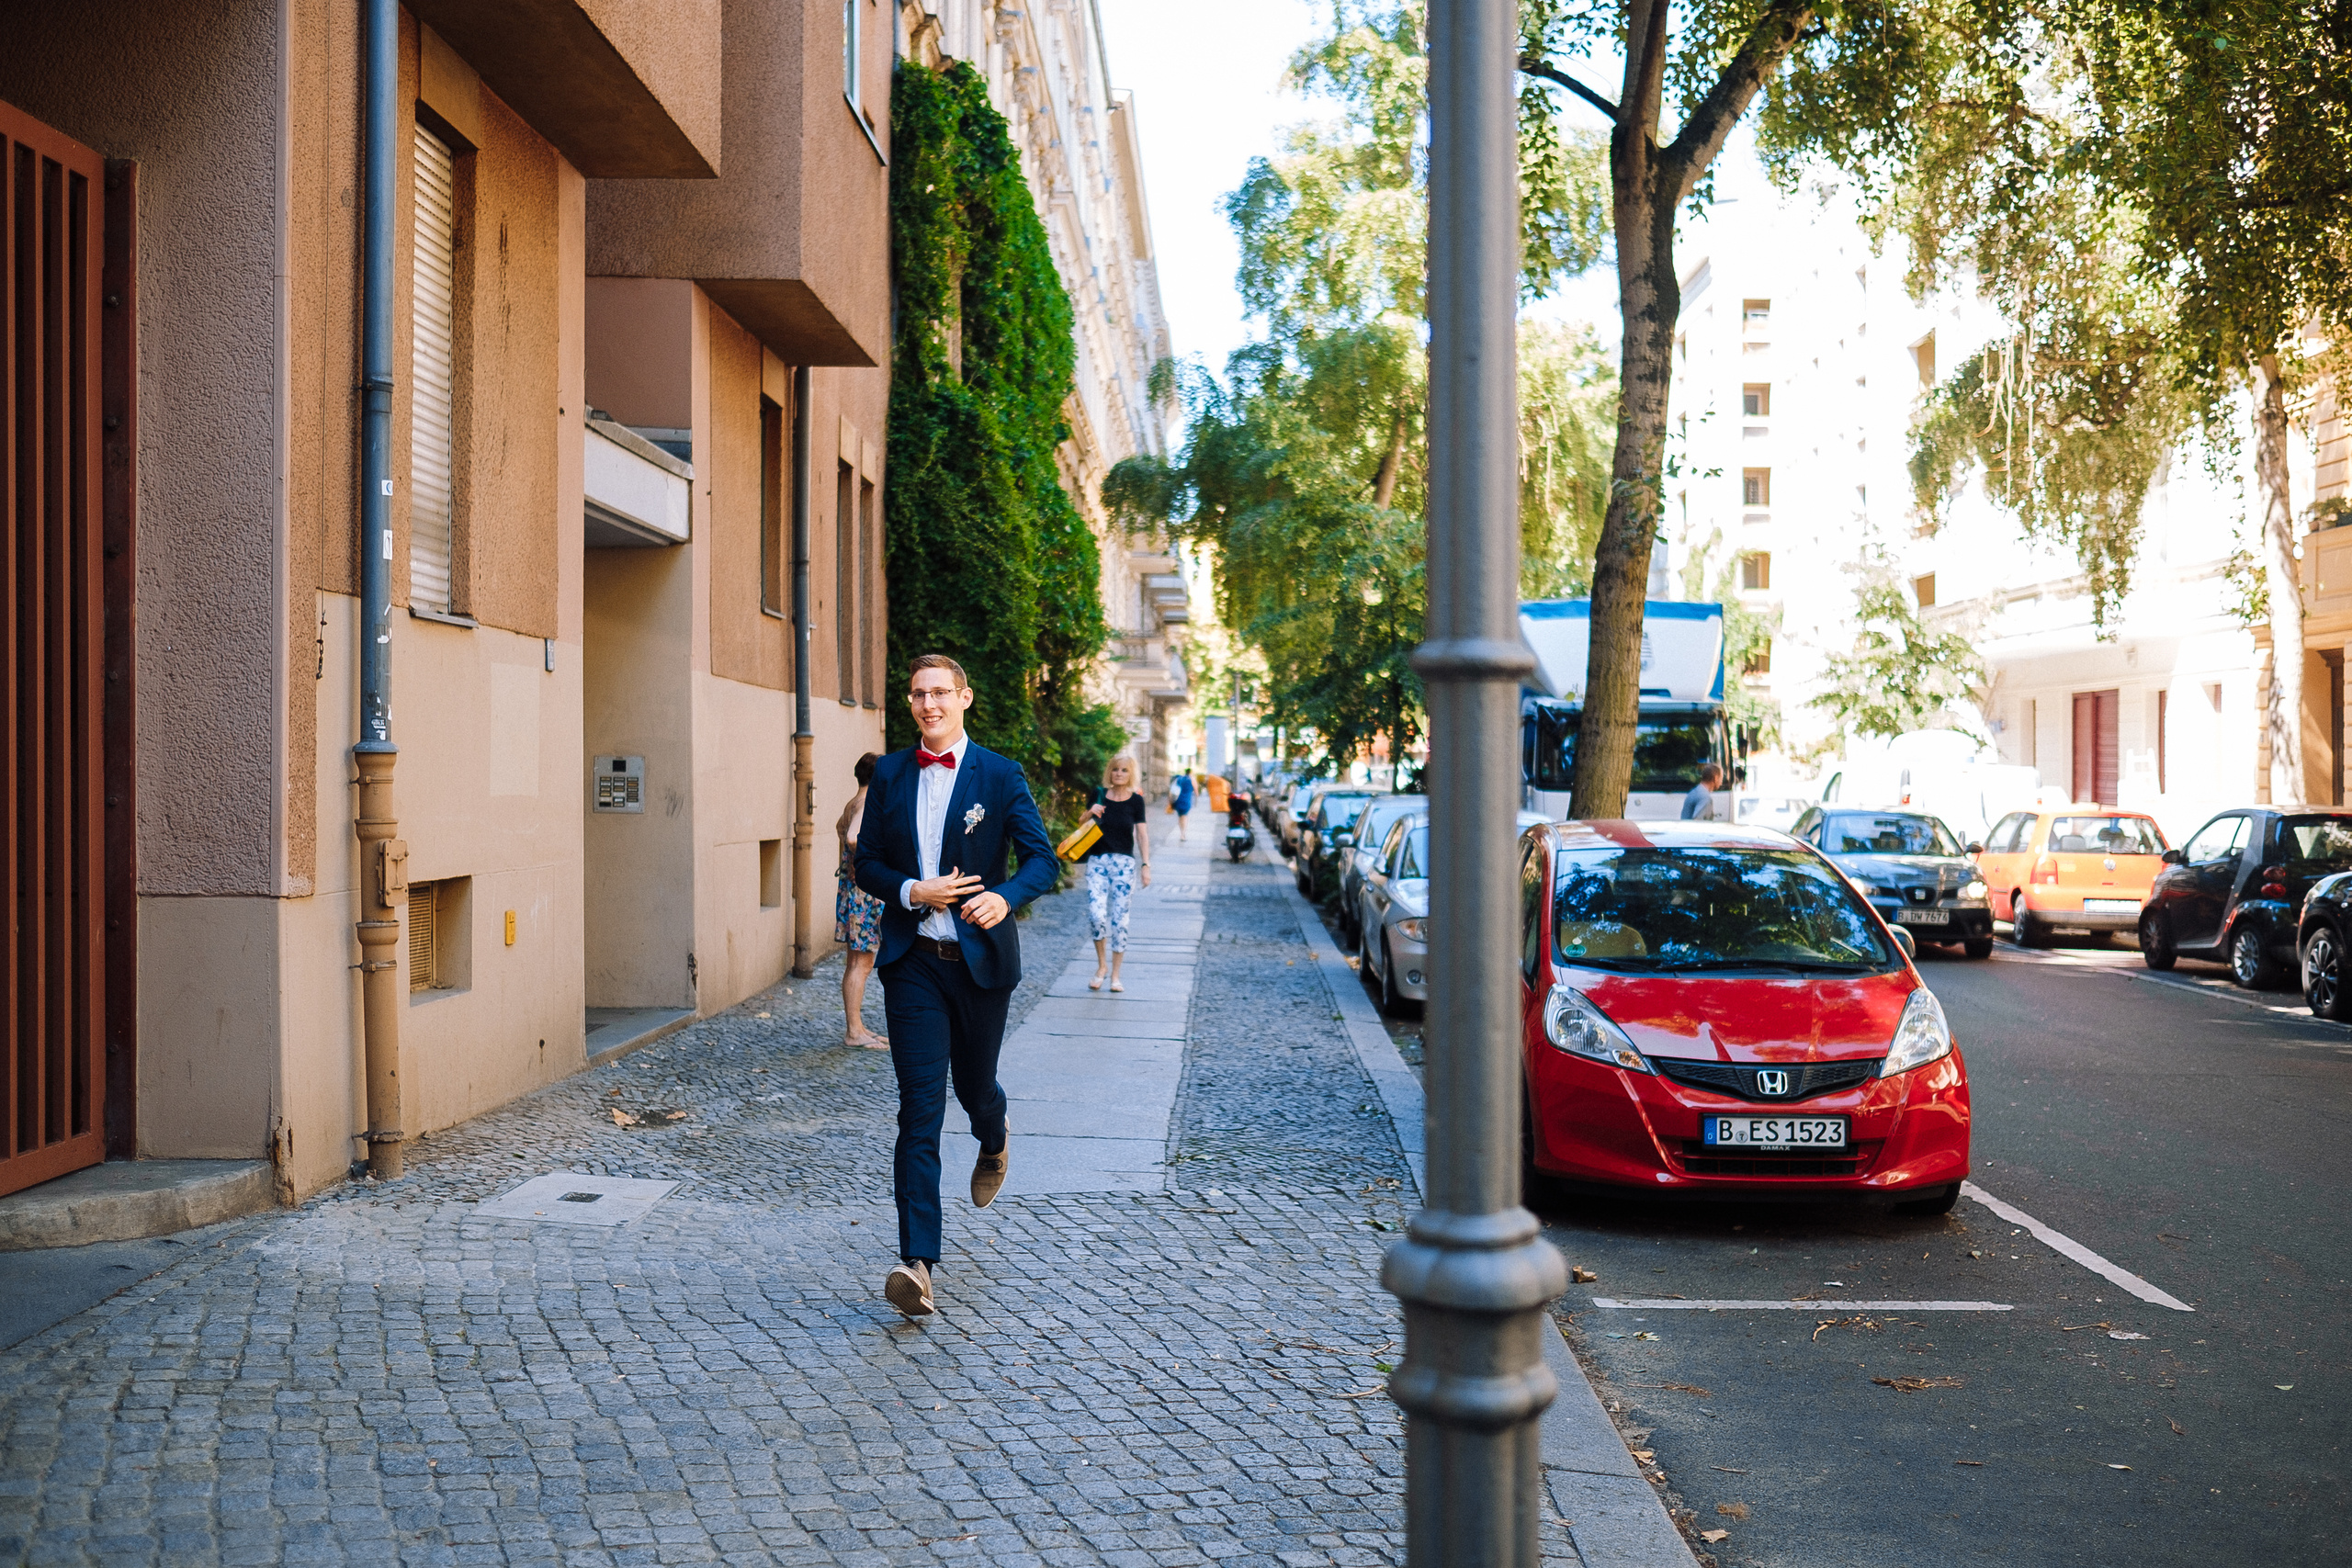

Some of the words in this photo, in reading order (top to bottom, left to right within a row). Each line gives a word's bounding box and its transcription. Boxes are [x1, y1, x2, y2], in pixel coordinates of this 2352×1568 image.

[1719, 1120, 1733, 1142] B
[1749, 1120, 1780, 1142] ES
[1784, 1121, 1842, 1144] 1523
